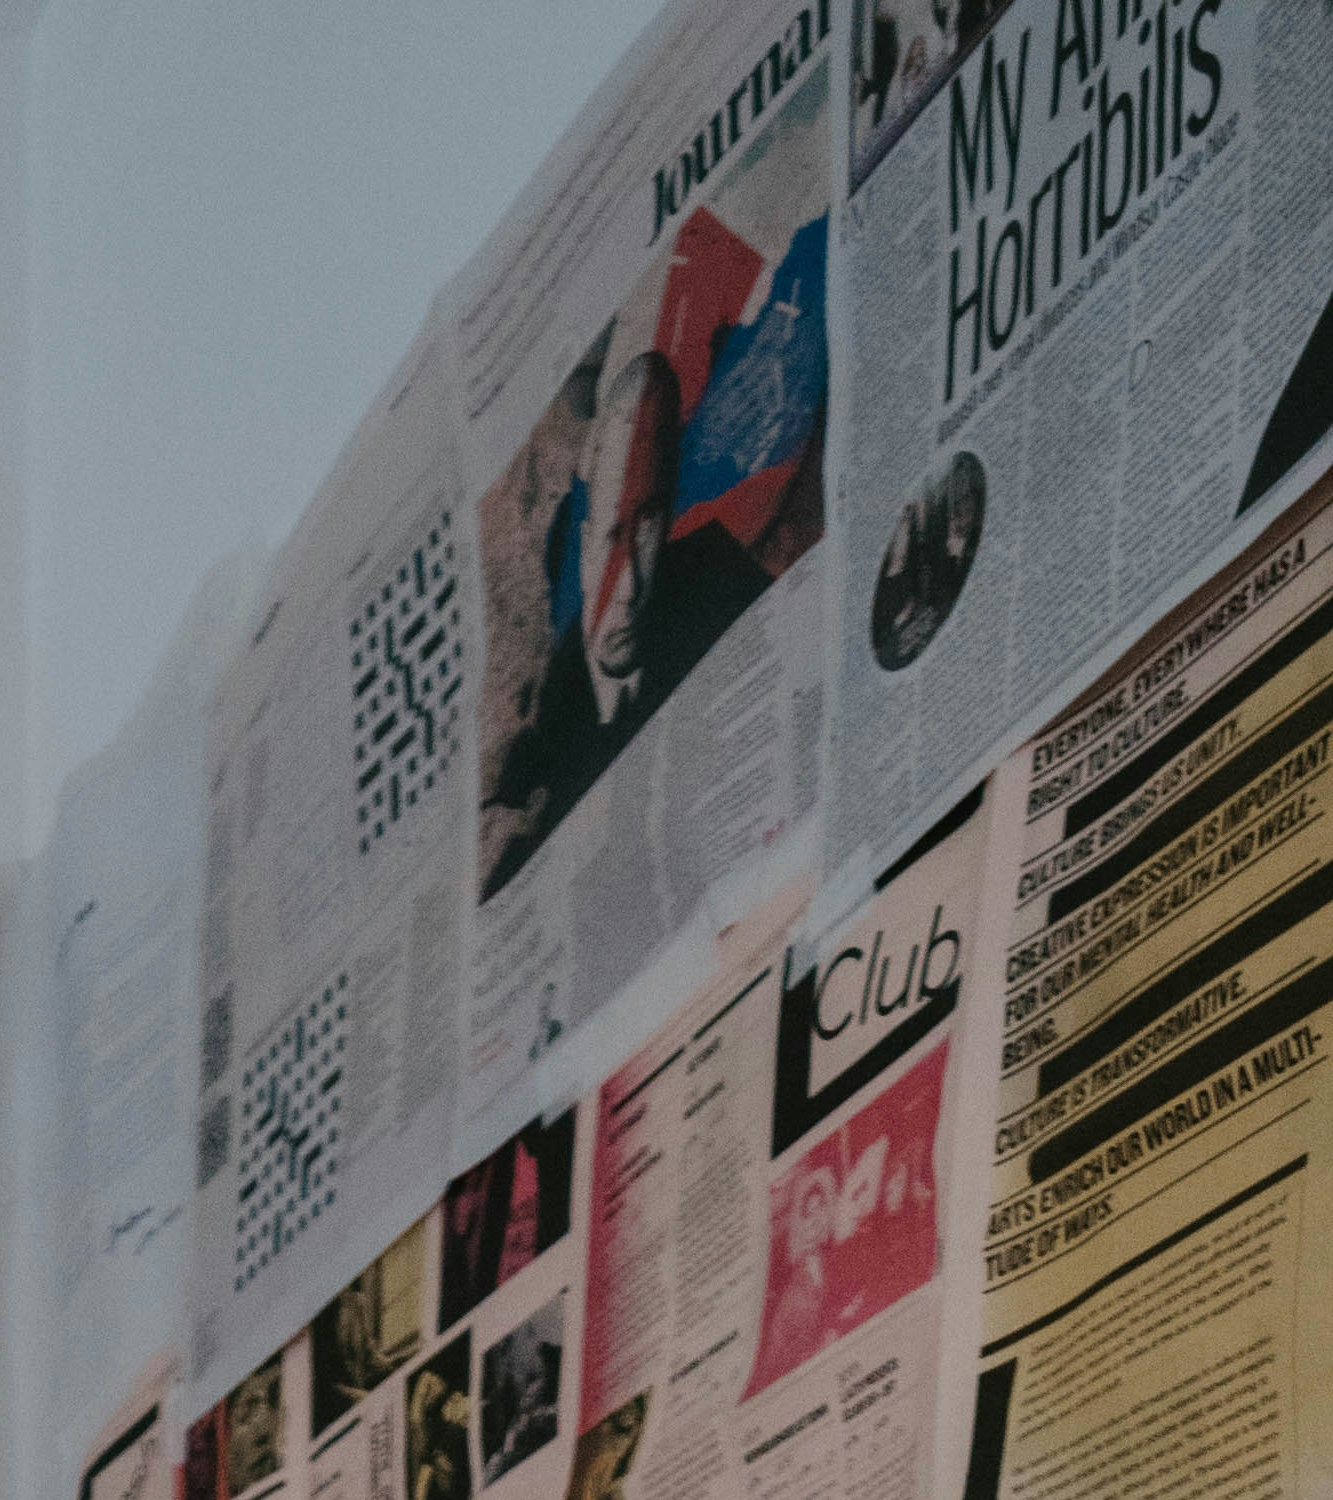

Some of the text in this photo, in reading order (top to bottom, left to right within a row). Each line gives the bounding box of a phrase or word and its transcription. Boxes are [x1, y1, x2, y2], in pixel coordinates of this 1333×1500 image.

[945, 0, 1225, 403] Horribilis
[949, 30, 1032, 234] My
[1132, 585, 1251, 704] EVERYWHERE
[1251, 549, 1290, 605] HAS
[1005, 729, 1332, 984] CREATIVE EXPRESSION IS IMPORTANT
[1017, 829, 1099, 901] CULTURE
[1099, 780, 1160, 848] BRINGS
[1027, 761, 1084, 818] RIGHT
[1086, 742, 1110, 779] TO
[1004, 988, 1040, 1029] FOR
[1041, 960, 1076, 1005] OUR
[1077, 914, 1143, 979] MENTAL
[1144, 859, 1215, 929] HEALTH
[1216, 830, 1257, 876] AND
[985, 1192, 1037, 1241] ARTS
[1039, 1154, 1105, 1215] ENRICH
[1106, 1131, 1144, 1177] OUR
[1144, 1090, 1213, 1153] WORLD
[1214, 1073, 1237, 1111] IN
[1237, 1067, 1253, 1097] A
[994, 1090, 1070, 1156] CULTURE
[1070, 1078, 1089, 1108] IS
[984, 1238, 1036, 1282] TUDE
[1036, 1223, 1060, 1258] OF
